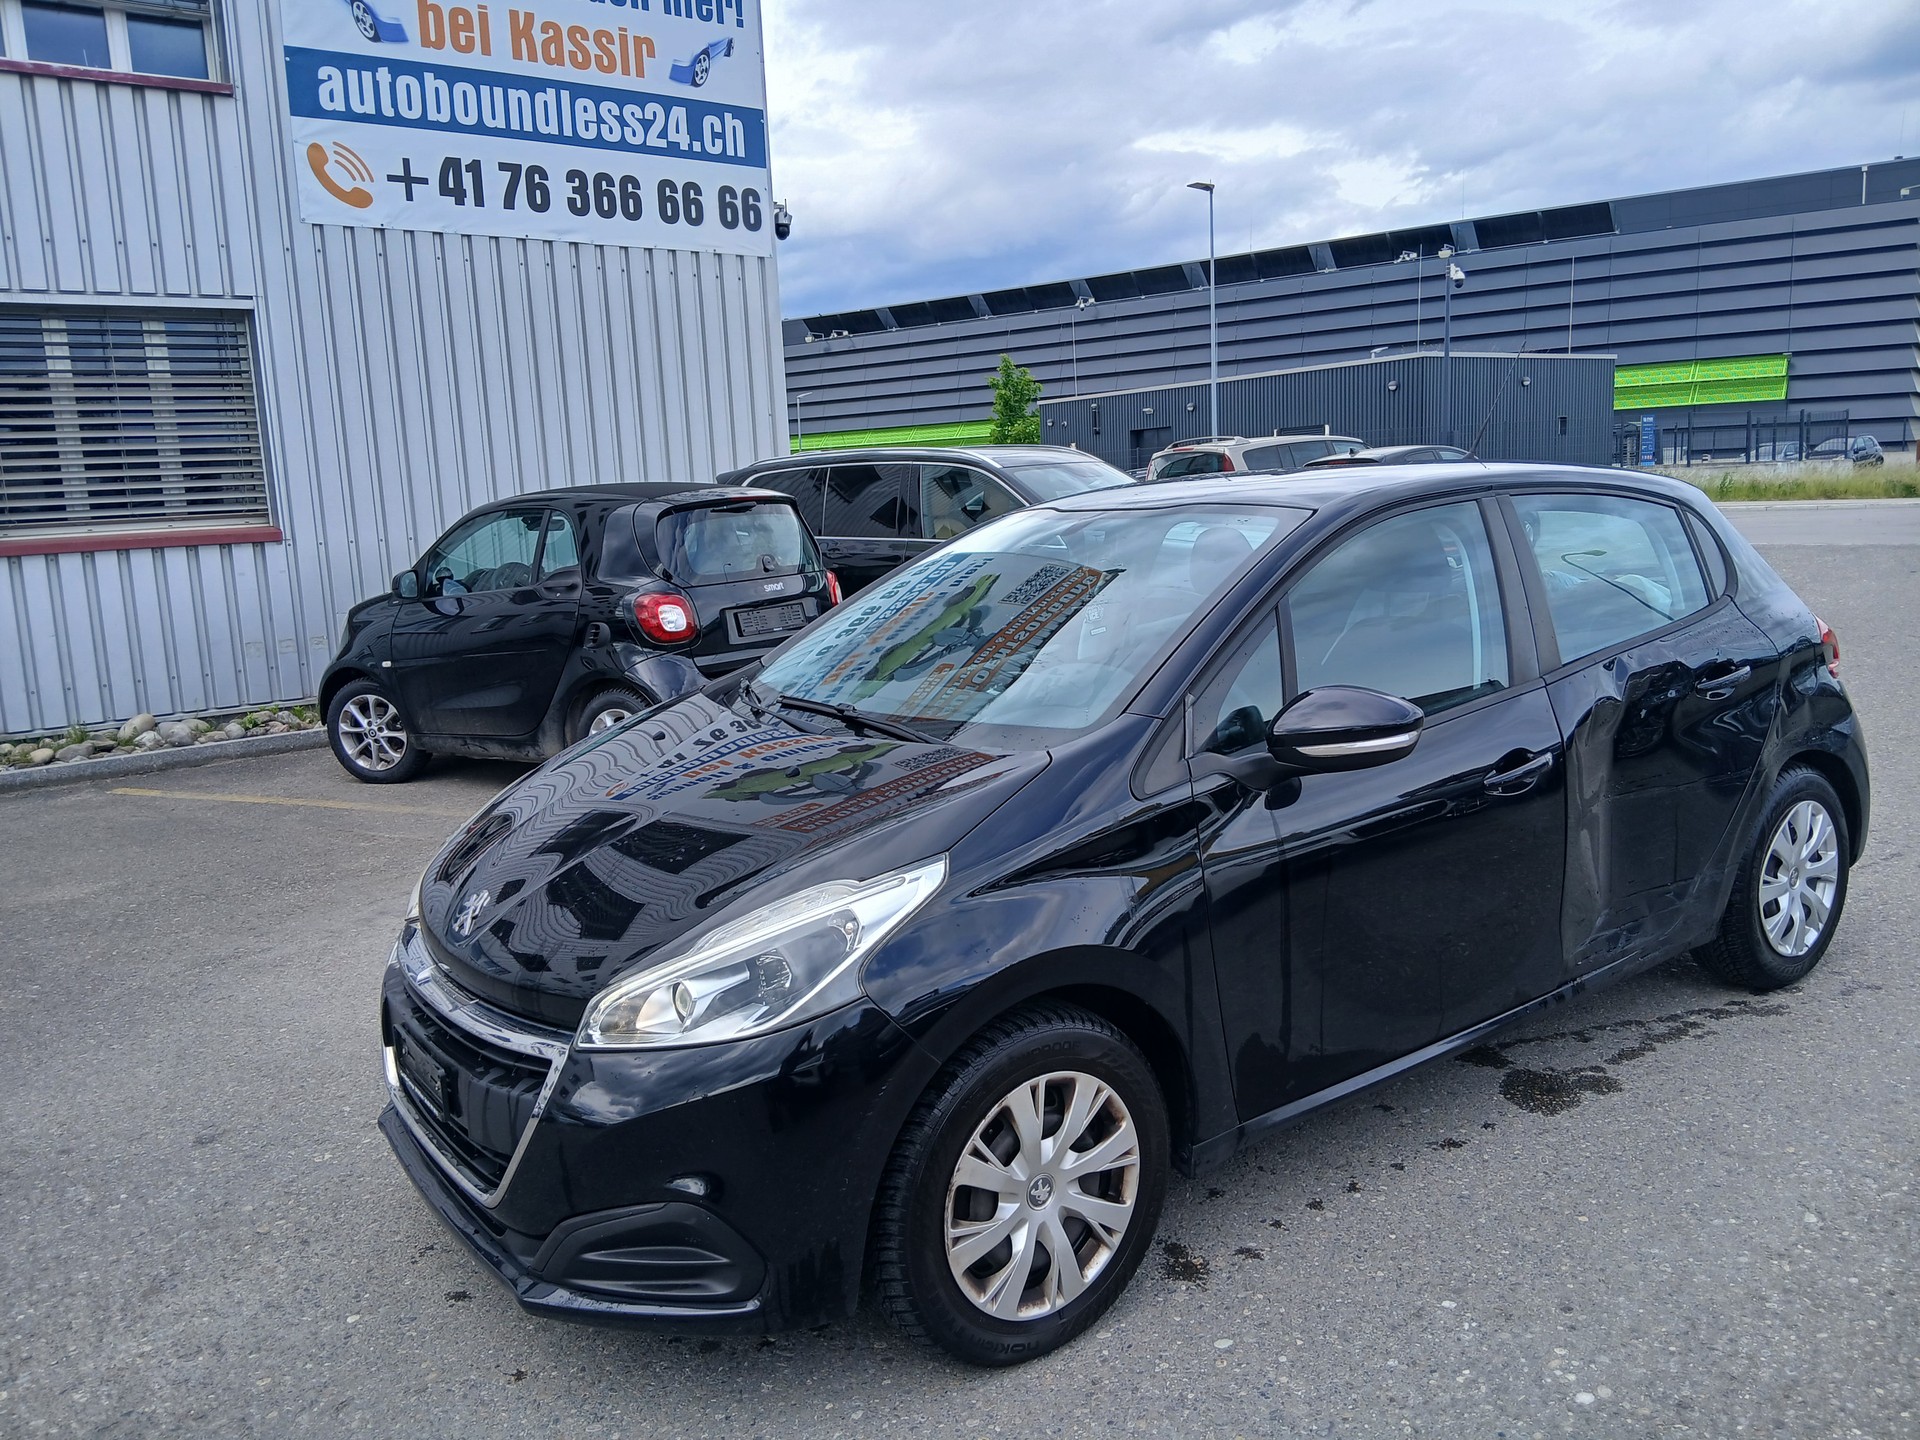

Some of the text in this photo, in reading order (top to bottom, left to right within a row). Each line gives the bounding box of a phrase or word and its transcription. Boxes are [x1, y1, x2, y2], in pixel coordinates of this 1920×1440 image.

[417, 0, 656, 79] bei Kassir
[317, 65, 746, 158] autoboundless24.ch
[438, 156, 486, 207] 41
[497, 161, 551, 213] 76
[564, 168, 643, 222] 366
[656, 178, 704, 226] 66
[718, 186, 762, 232] 66
[763, 582, 785, 593] smart
